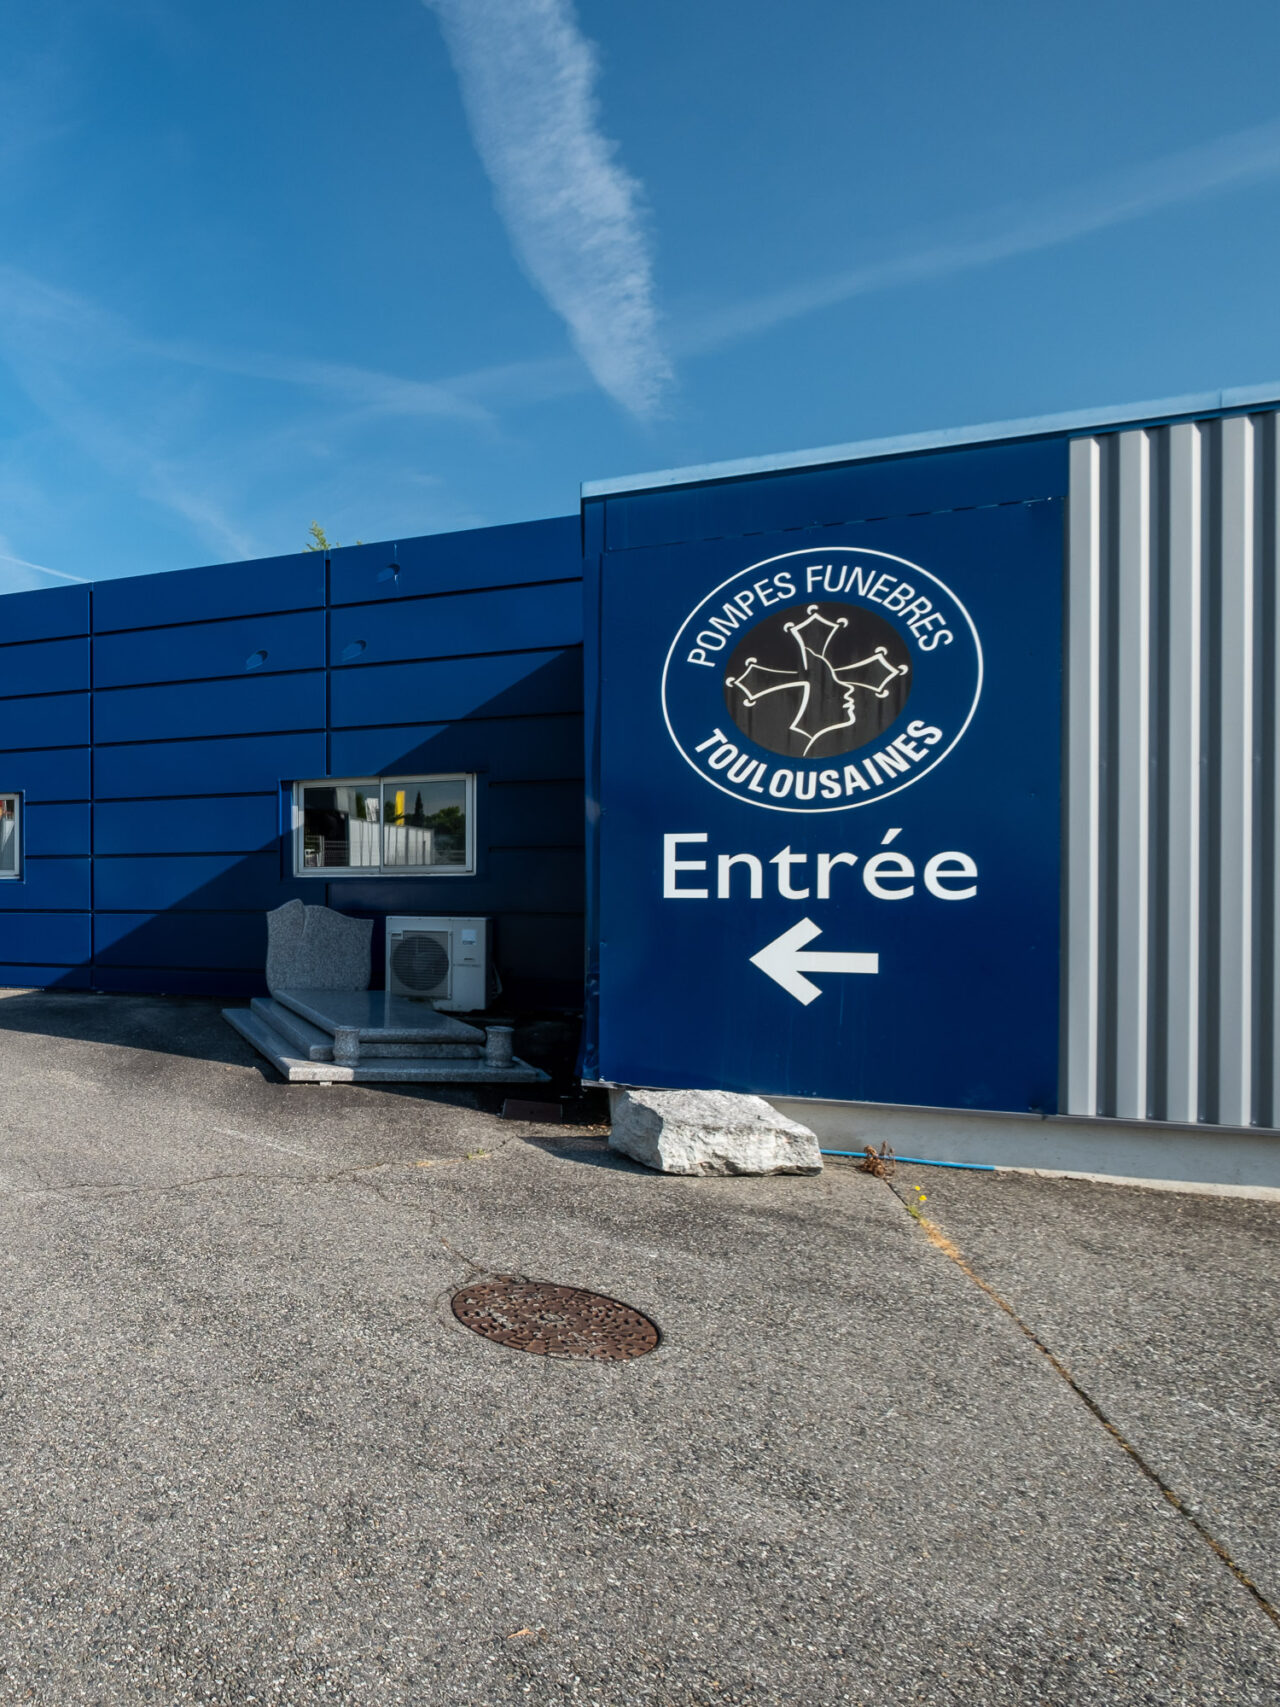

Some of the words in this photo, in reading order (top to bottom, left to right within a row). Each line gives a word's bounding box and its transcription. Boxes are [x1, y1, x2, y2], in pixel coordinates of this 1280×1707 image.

[687, 571, 796, 667] POMPES
[806, 564, 954, 652] FUNEBRES
[694, 719, 943, 800] TOULOUSAINES
[663, 827, 978, 900] Entrée
